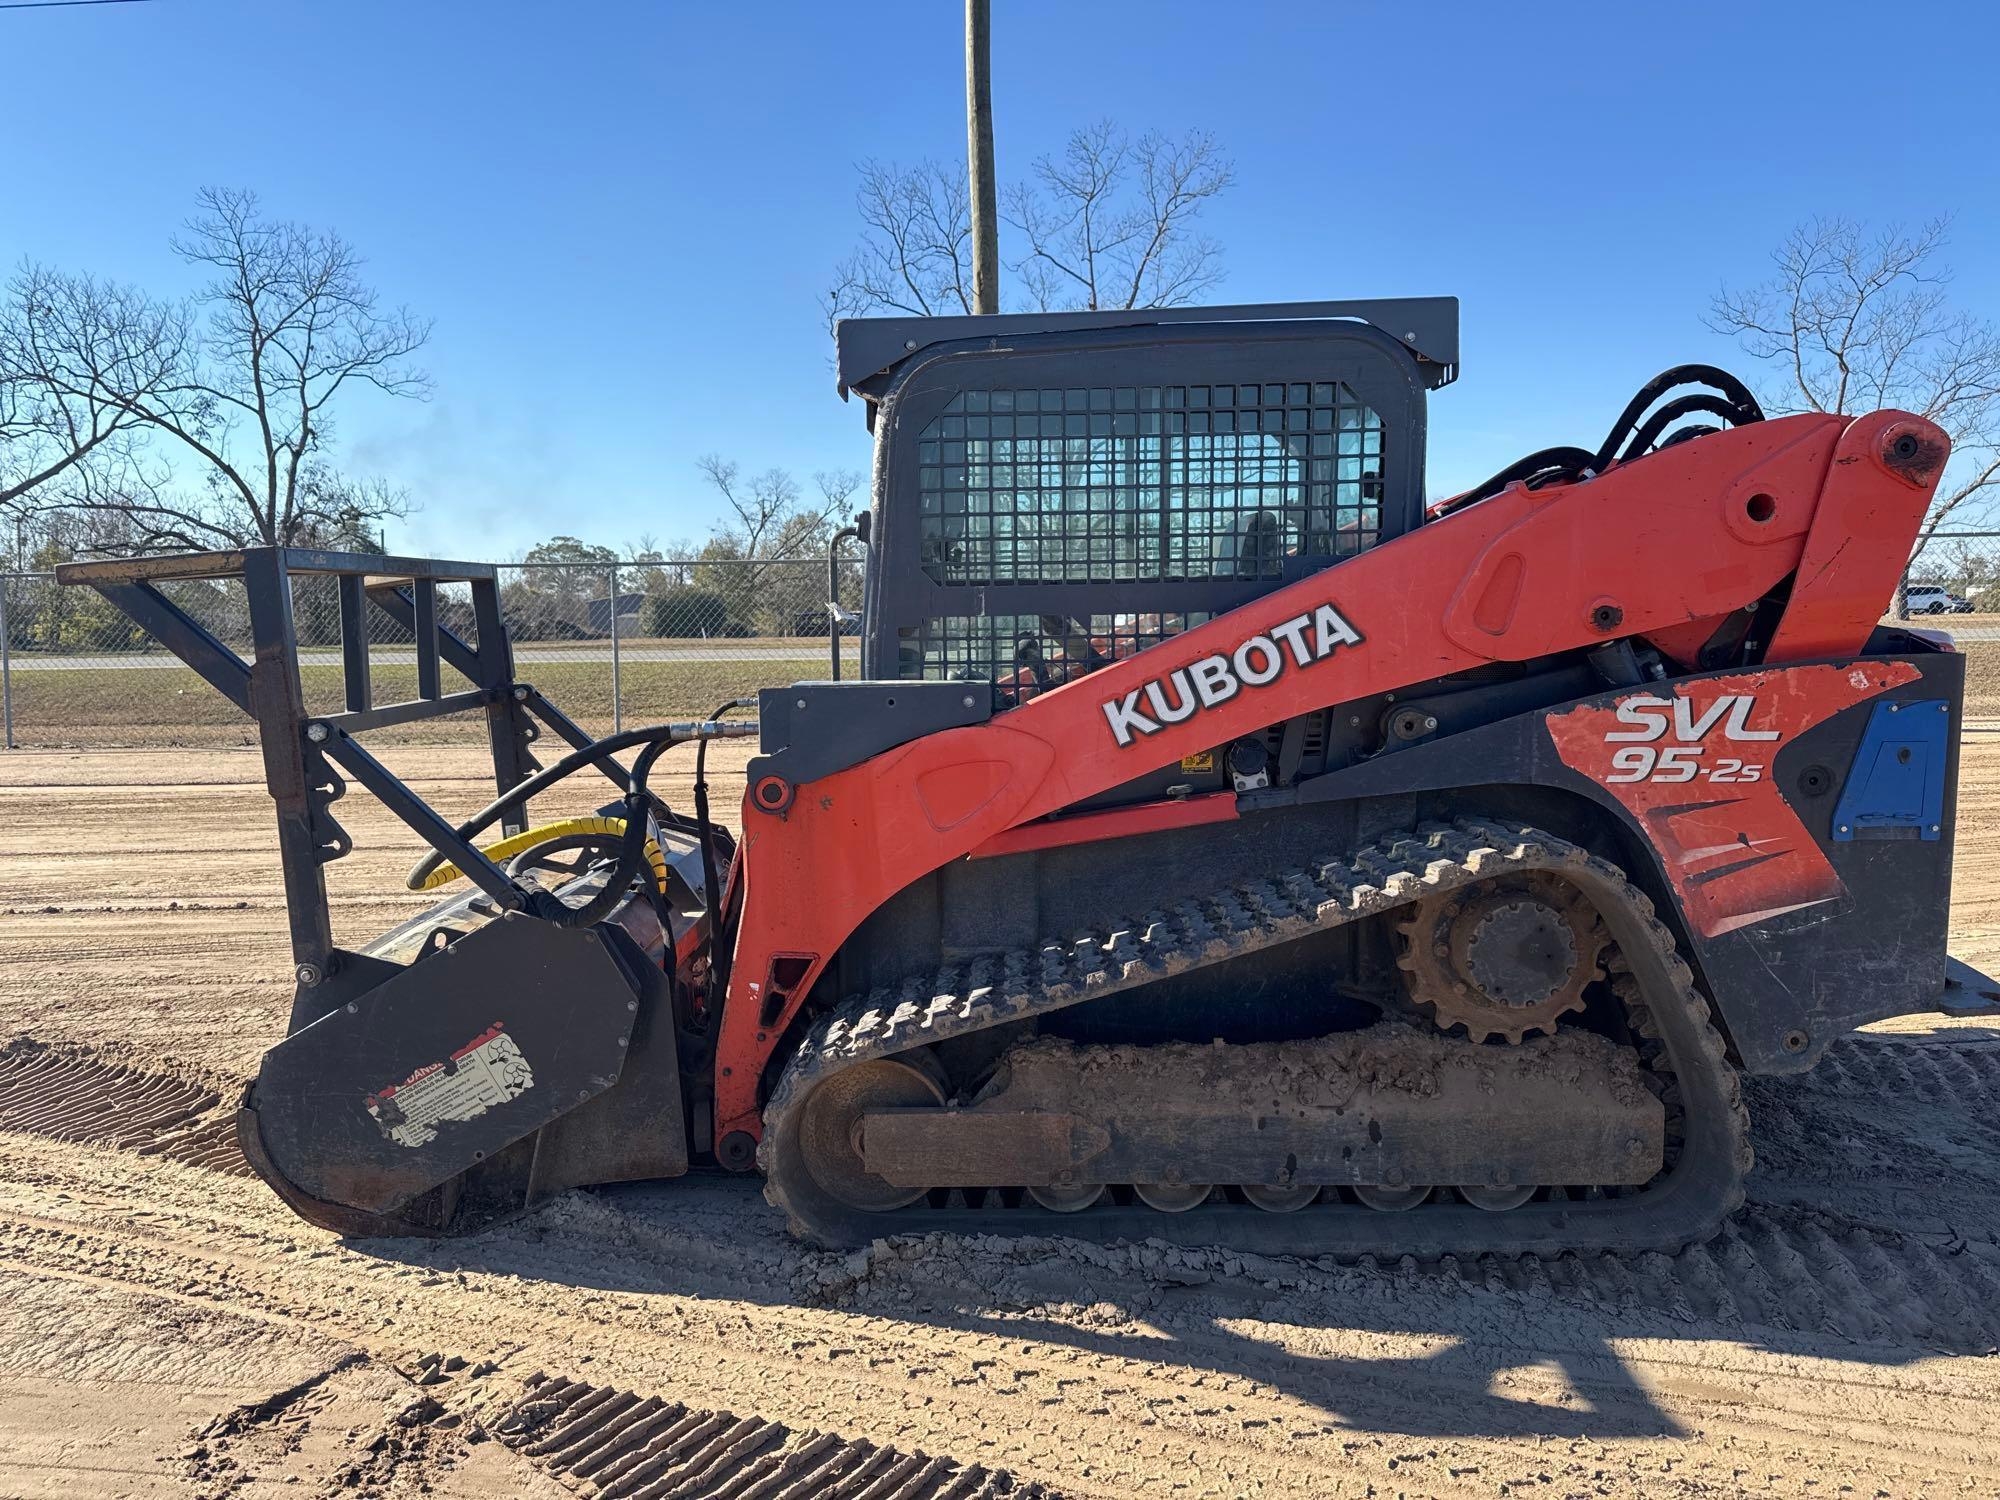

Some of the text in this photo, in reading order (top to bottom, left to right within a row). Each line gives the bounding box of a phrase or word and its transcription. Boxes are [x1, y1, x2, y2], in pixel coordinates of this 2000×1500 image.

[1101, 602, 1365, 748] KUBOTA
[1604, 695, 1783, 742] SVL
[398, 1092, 414, 1103] CAUSE
[414, 1081, 435, 1095] SERIOUS
[459, 1057, 475, 1069] DEATH
[405, 1062, 443, 1082] DANG
[405, 1079, 427, 1094] OBJECTS
[457, 1053, 472, 1064] DRUM
